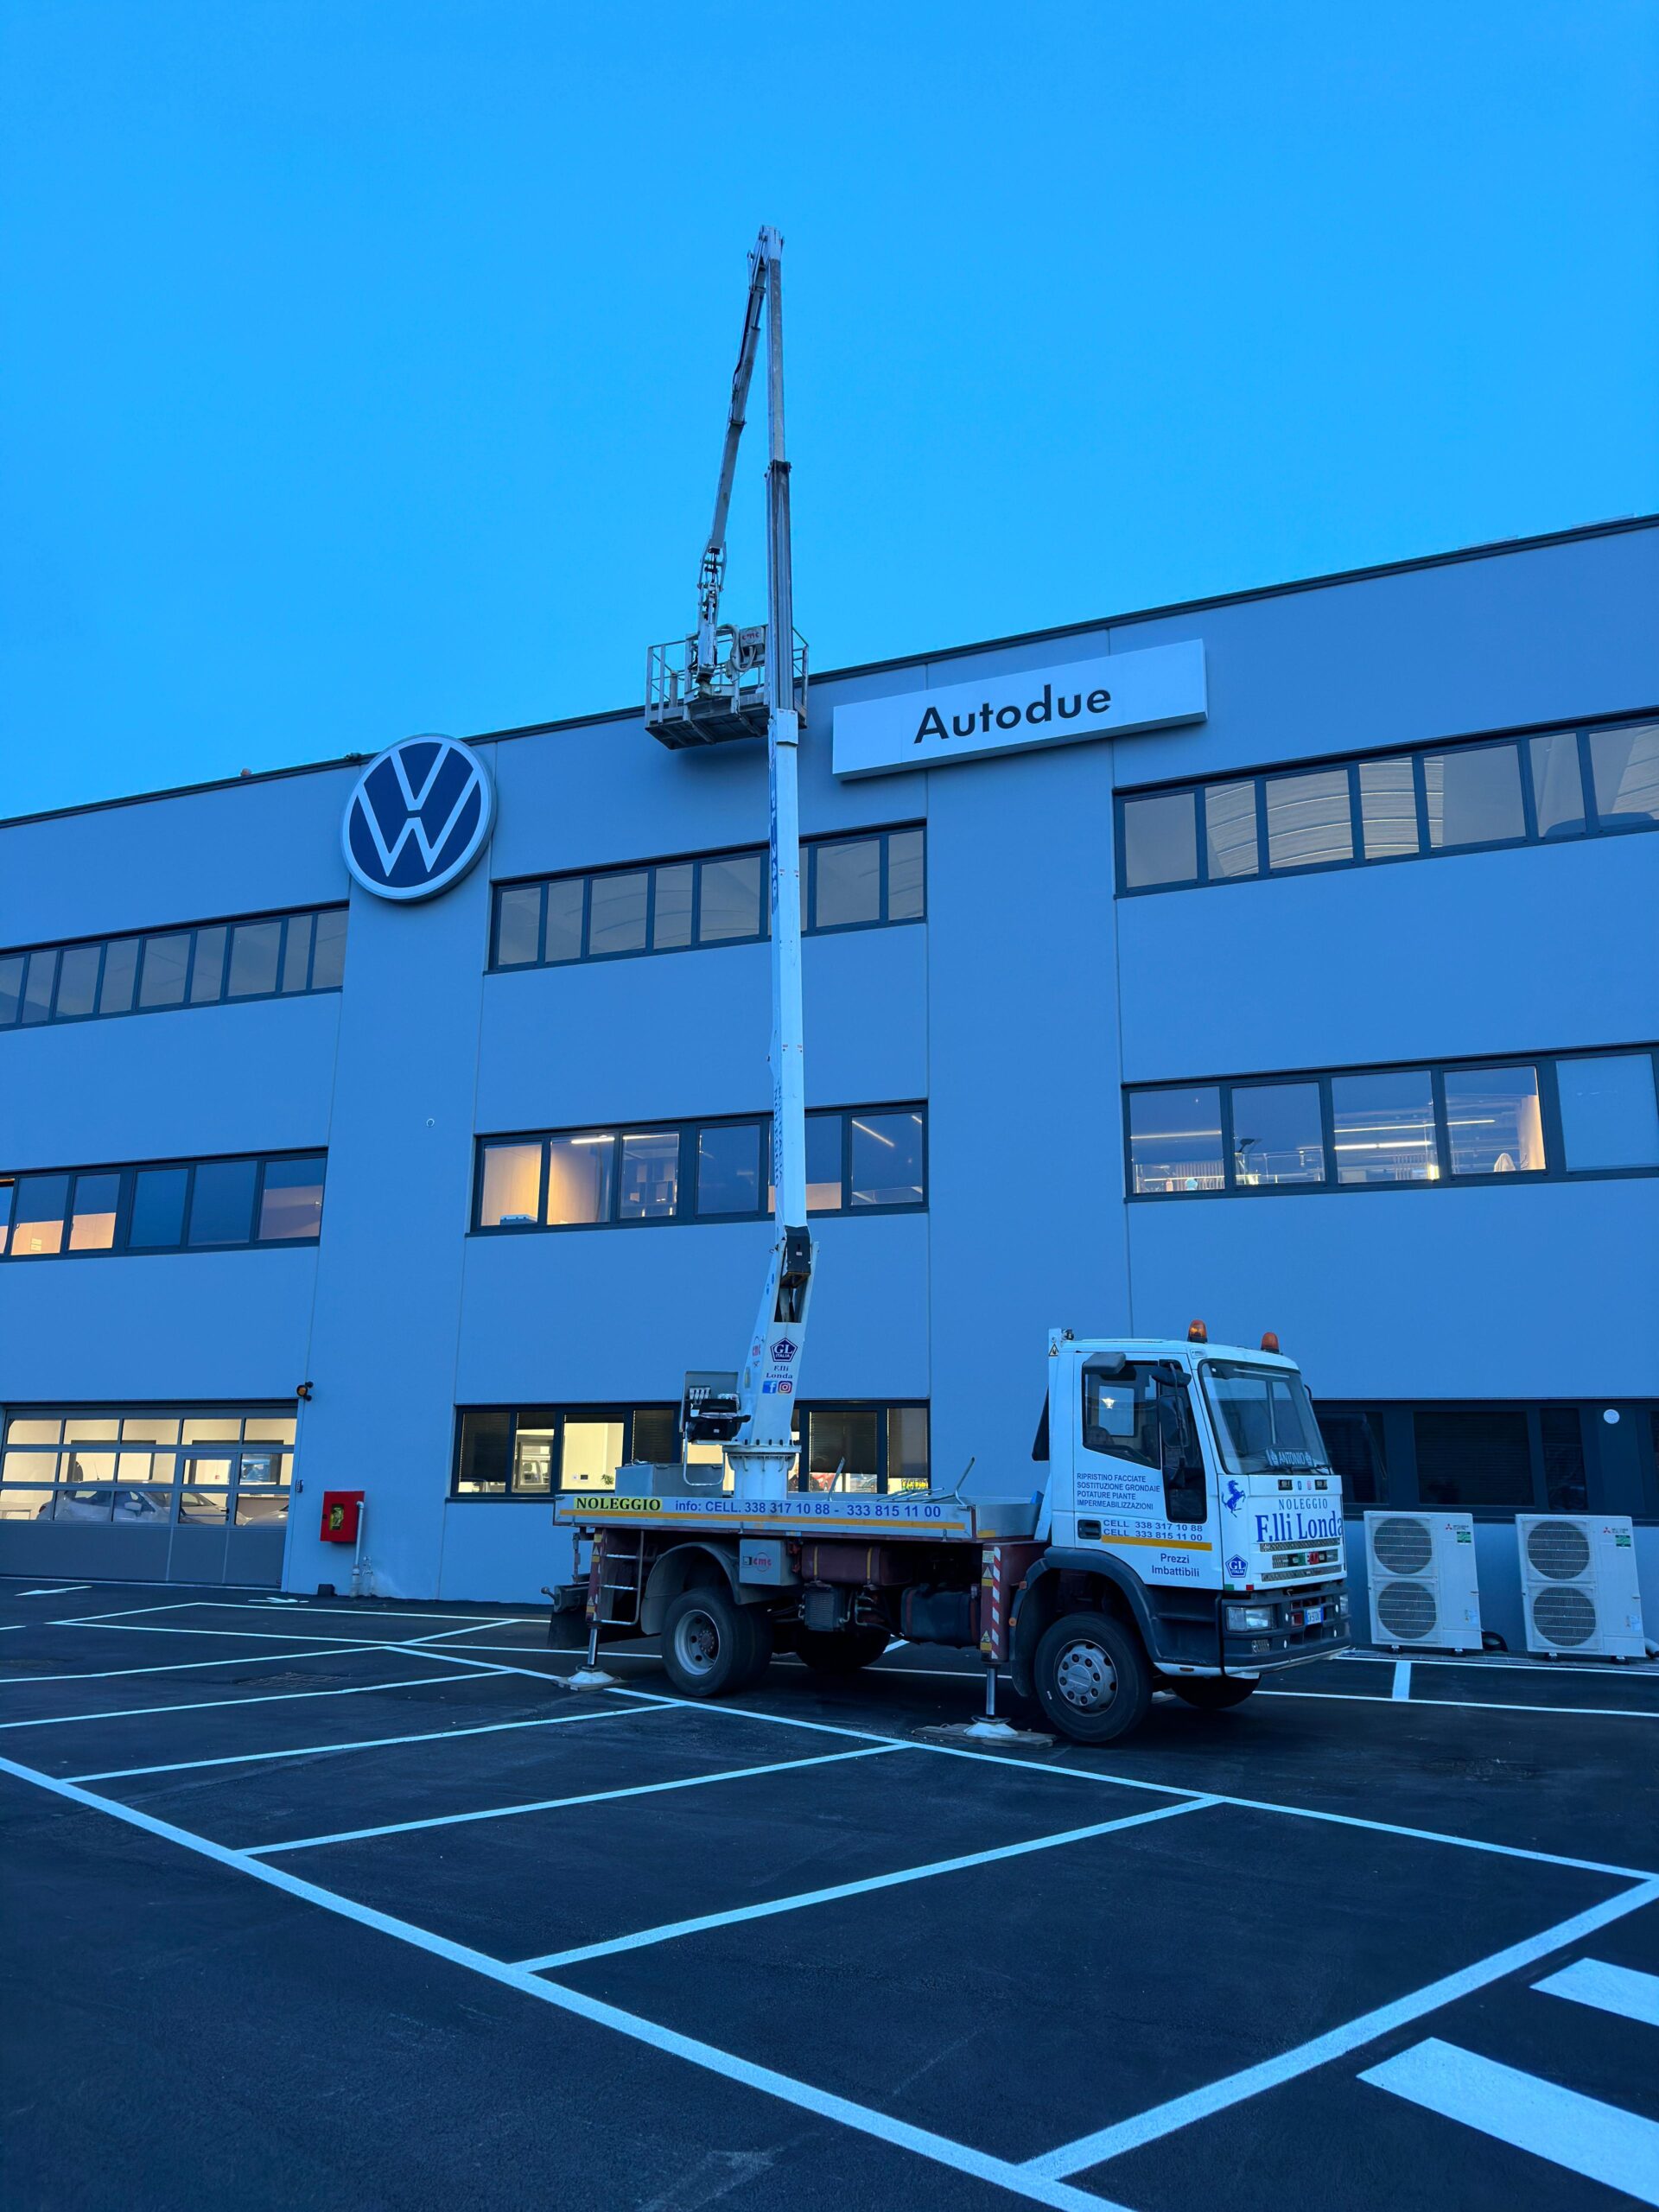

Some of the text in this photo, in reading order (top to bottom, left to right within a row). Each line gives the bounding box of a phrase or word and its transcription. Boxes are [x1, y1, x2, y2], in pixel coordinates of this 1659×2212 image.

[913, 683, 1111, 745] Autodue
[773, 1344, 793, 1354] GL
[1279, 1452, 1306, 1465] ANTONIO
[1077, 1472, 1147, 1483] RIPRISTINO FACCIATE
[1077, 1481, 1161, 1492] SOSTITUZIONE GRONDAIE
[575, 1497, 661, 1511] NOLEGGIO
[675, 1500, 702, 1512] info:
[705, 1501, 741, 1513] CELL.
[744, 1502, 766, 1513] 338
[770, 1503, 791, 1513] 317
[796, 1503, 810, 1514] 10
[815, 1503, 830, 1515] 88
[847, 1504, 870, 1516] 333
[874, 1505, 899, 1516] 815
[904, 1505, 918, 1517] 11
[924, 1505, 941, 1517] 00
[1077, 1499, 1154, 1510] IMPERMEABILIZZAZIONI
[1278, 1498, 1328, 1510] NOLEGGIO
[1103, 1519, 1129, 1528] CELL
[1255, 1510, 1343, 1542] F.lli Londa
[1160, 1553, 1190, 1564] Prezzi
[1229, 1560, 1245, 1570] GL
[1151, 1565, 1199, 1577] Imbattibili
